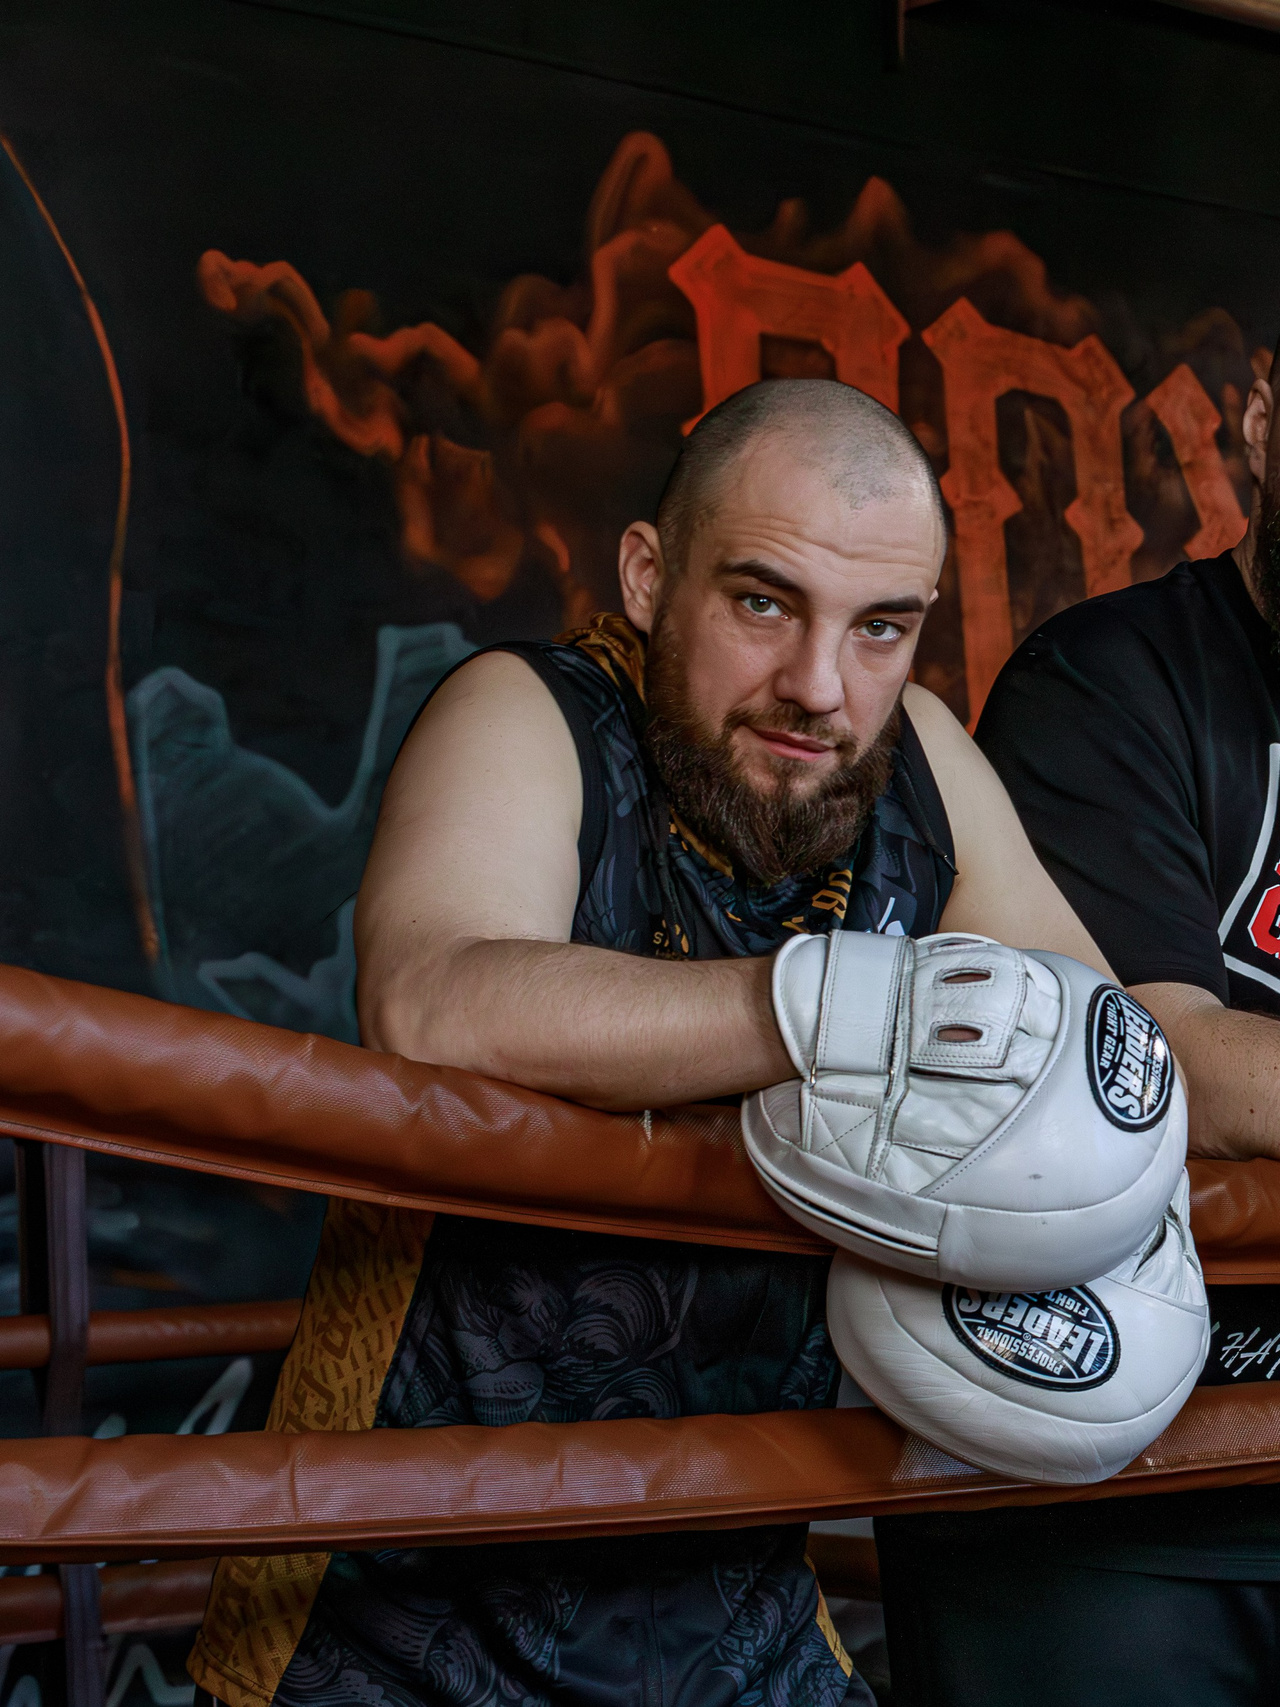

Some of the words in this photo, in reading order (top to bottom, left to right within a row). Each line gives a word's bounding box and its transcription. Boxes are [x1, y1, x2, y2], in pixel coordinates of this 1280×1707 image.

[1106, 1001, 1119, 1037] FIGHT
[1099, 1035, 1117, 1069] GEAR
[1107, 994, 1151, 1118] LEADERS
[1045, 1290, 1090, 1317] FIGHT
[976, 1325, 1063, 1376] PROFESSIONAL
